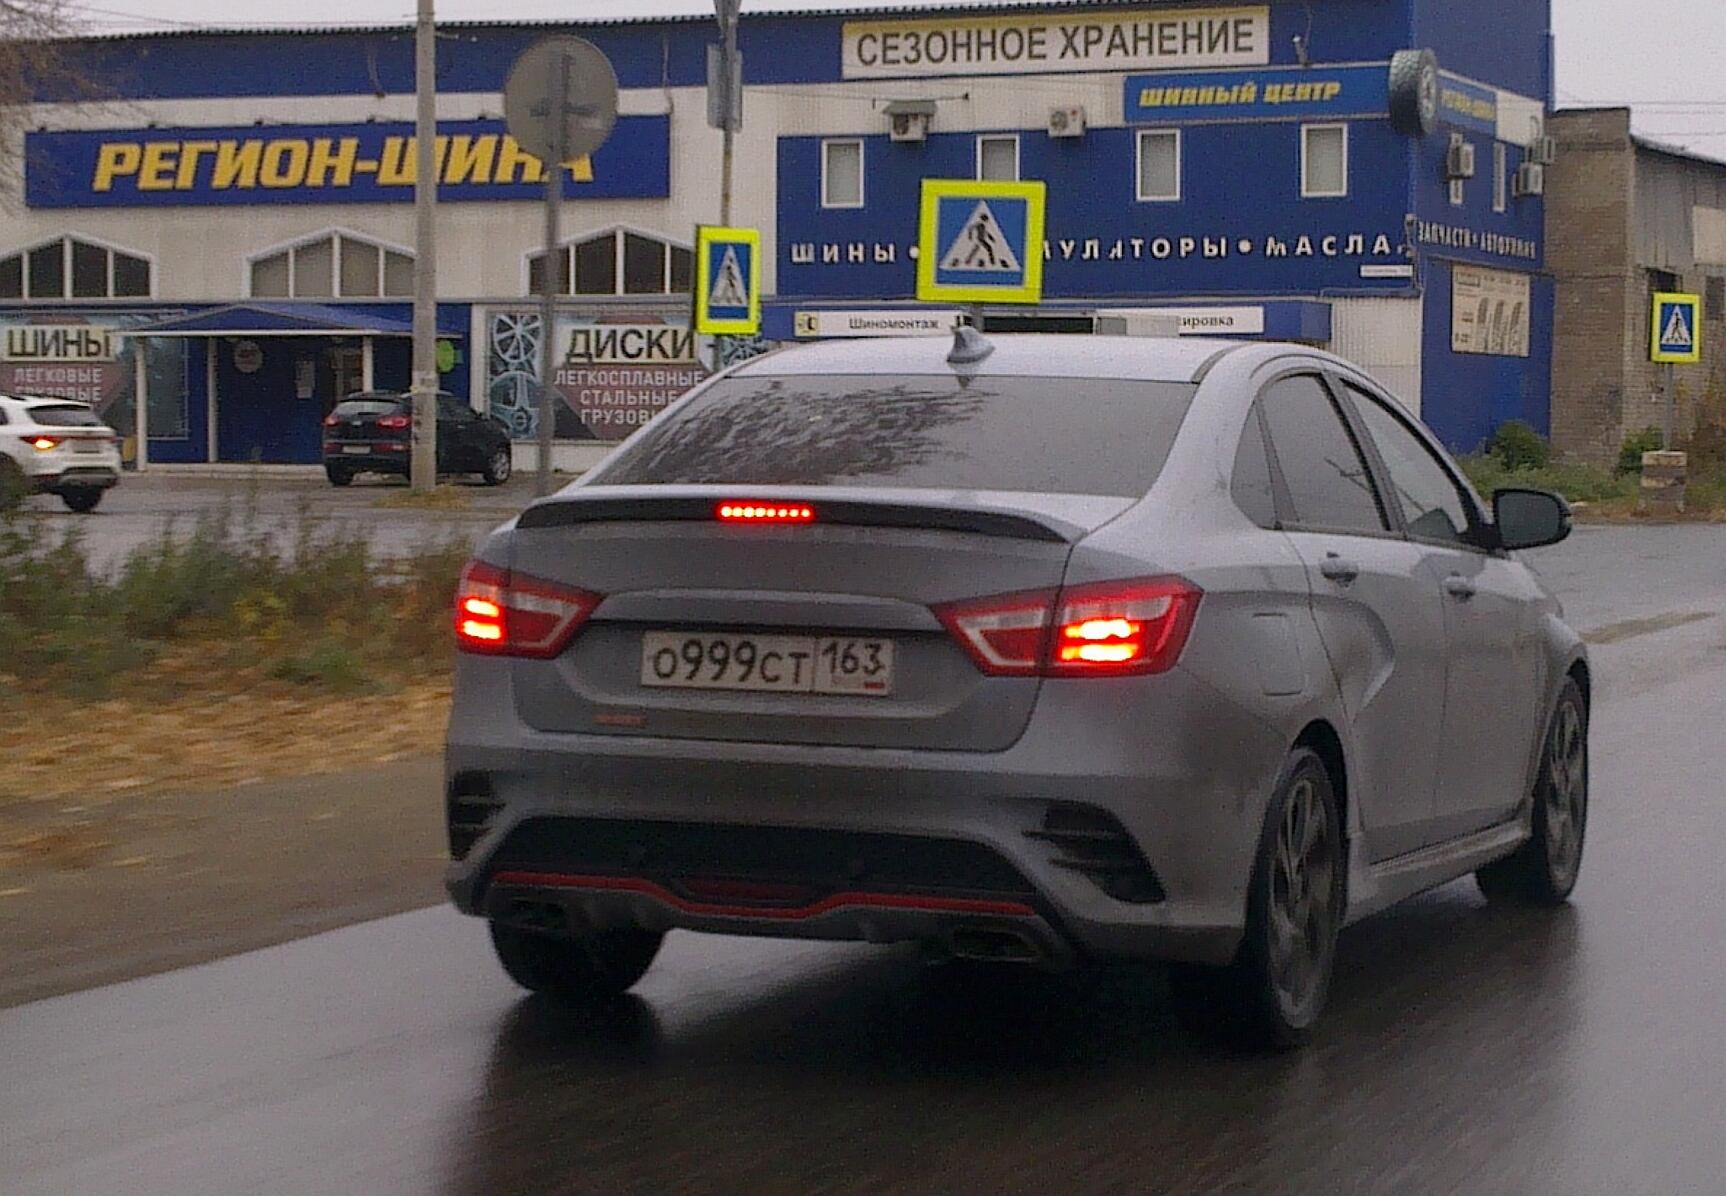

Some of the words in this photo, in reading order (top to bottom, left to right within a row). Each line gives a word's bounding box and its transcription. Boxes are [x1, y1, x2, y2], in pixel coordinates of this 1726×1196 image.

[856, 26, 1048, 67] СЕЗОННОЕ
[1058, 18, 1254, 59] ХРАНЕНИЕ
[1139, 81, 1257, 107] ШИННЫЙ
[1263, 82, 1341, 104] ЦЕНТР
[791, 242, 896, 264] ШИНЫ
[1265, 233, 1392, 257] МАСЛА
[849, 317, 940, 330] Шиномонтаж
[1180, 315, 1235, 330] ировка
[8, 328, 111, 358] ШИНЫ
[566, 328, 696, 364] ДИСКИ
[14, 367, 103, 383] ЛЕГКОВЫЕ
[554, 369, 704, 386] ЛЕГКОСПЛАВНЫЕ
[580, 389, 678, 405] СТАЛЬНЫЕ
[821, 640, 887, 676] 163
